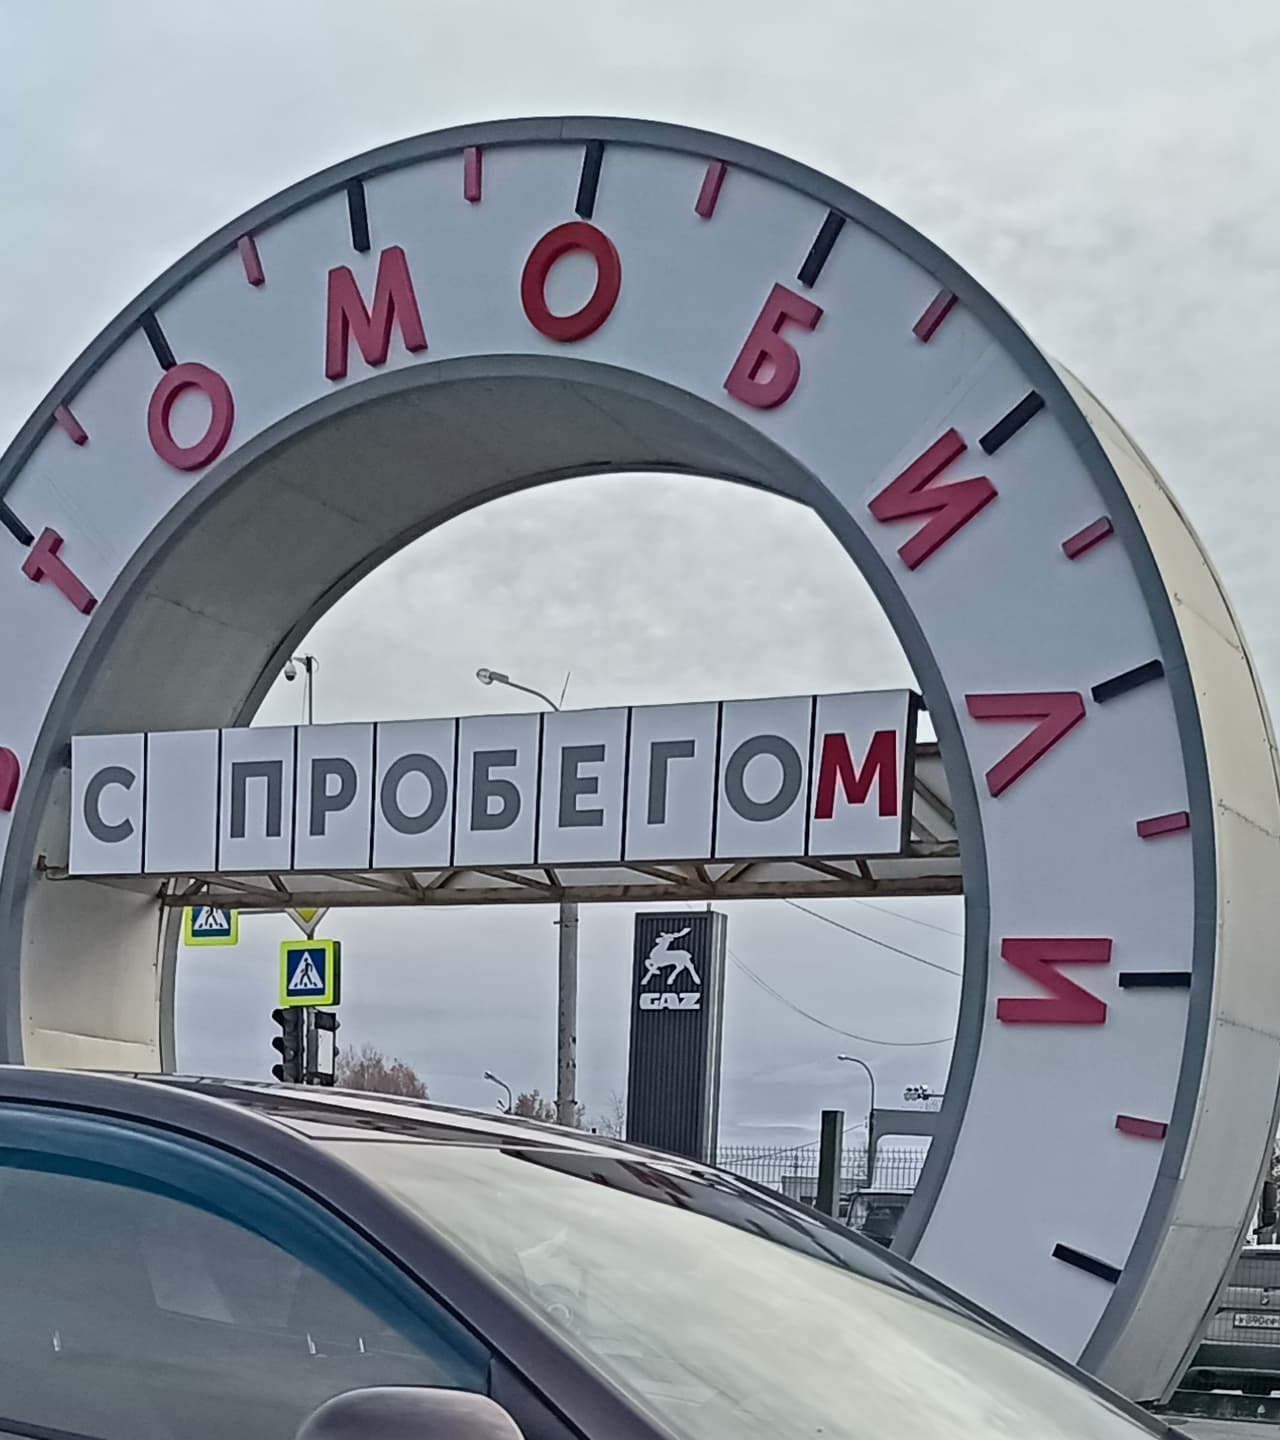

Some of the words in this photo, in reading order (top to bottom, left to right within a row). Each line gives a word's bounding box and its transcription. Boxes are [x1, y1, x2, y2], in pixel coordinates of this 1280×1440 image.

[83, 766, 134, 843] С
[230, 729, 898, 839] ПРОБЕГОМ
[640, 992, 700, 1010] GAZ
